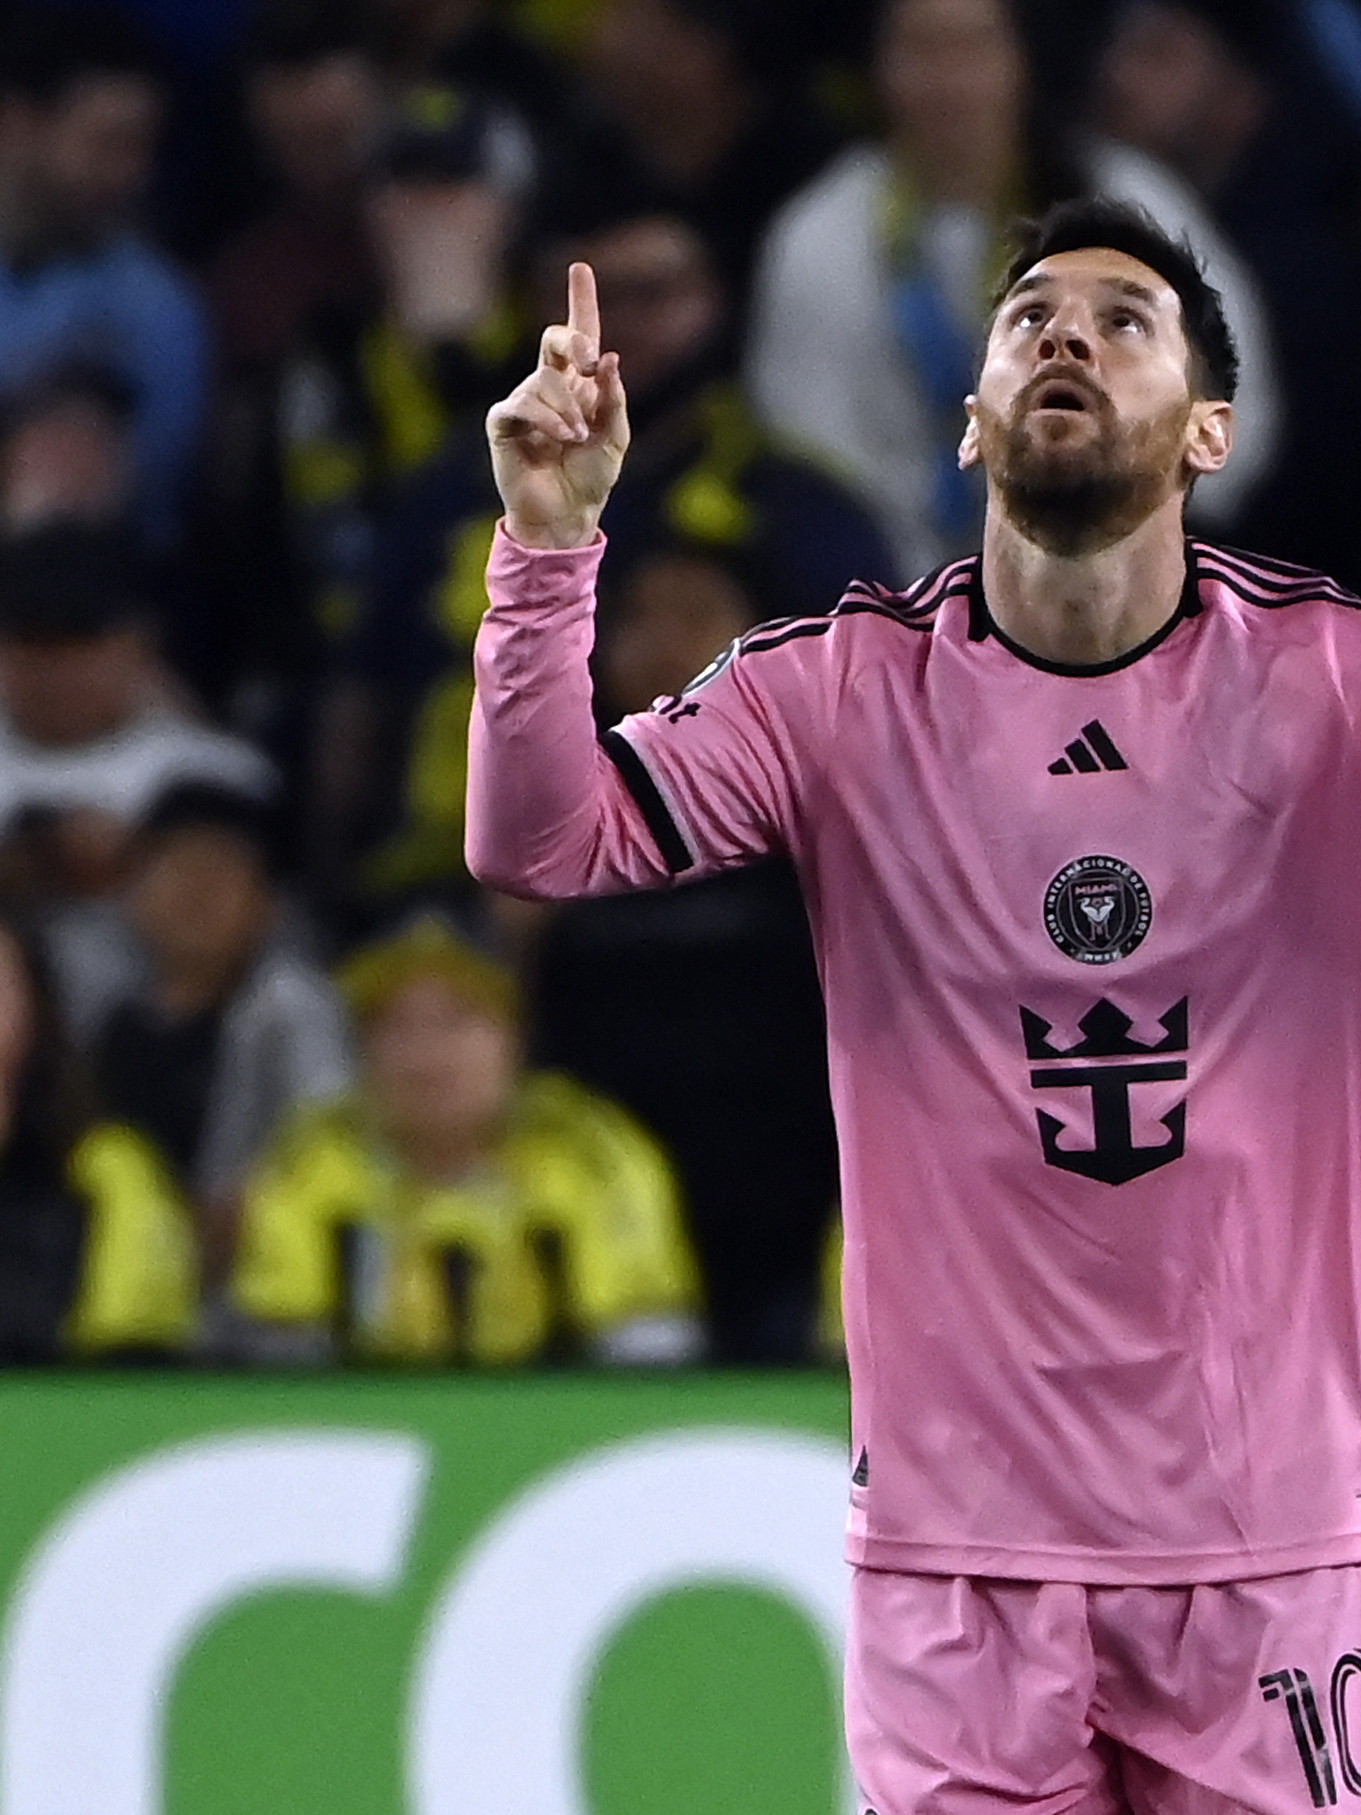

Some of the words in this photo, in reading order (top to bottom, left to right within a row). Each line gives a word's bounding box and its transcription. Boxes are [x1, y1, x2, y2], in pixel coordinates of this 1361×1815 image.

[1047, 859, 1131, 908] INTERNACIONAL
[1075, 884, 1118, 895] MIAMI
[1129, 875, 1144, 891] DE
[1047, 914, 1064, 943] CLUB
